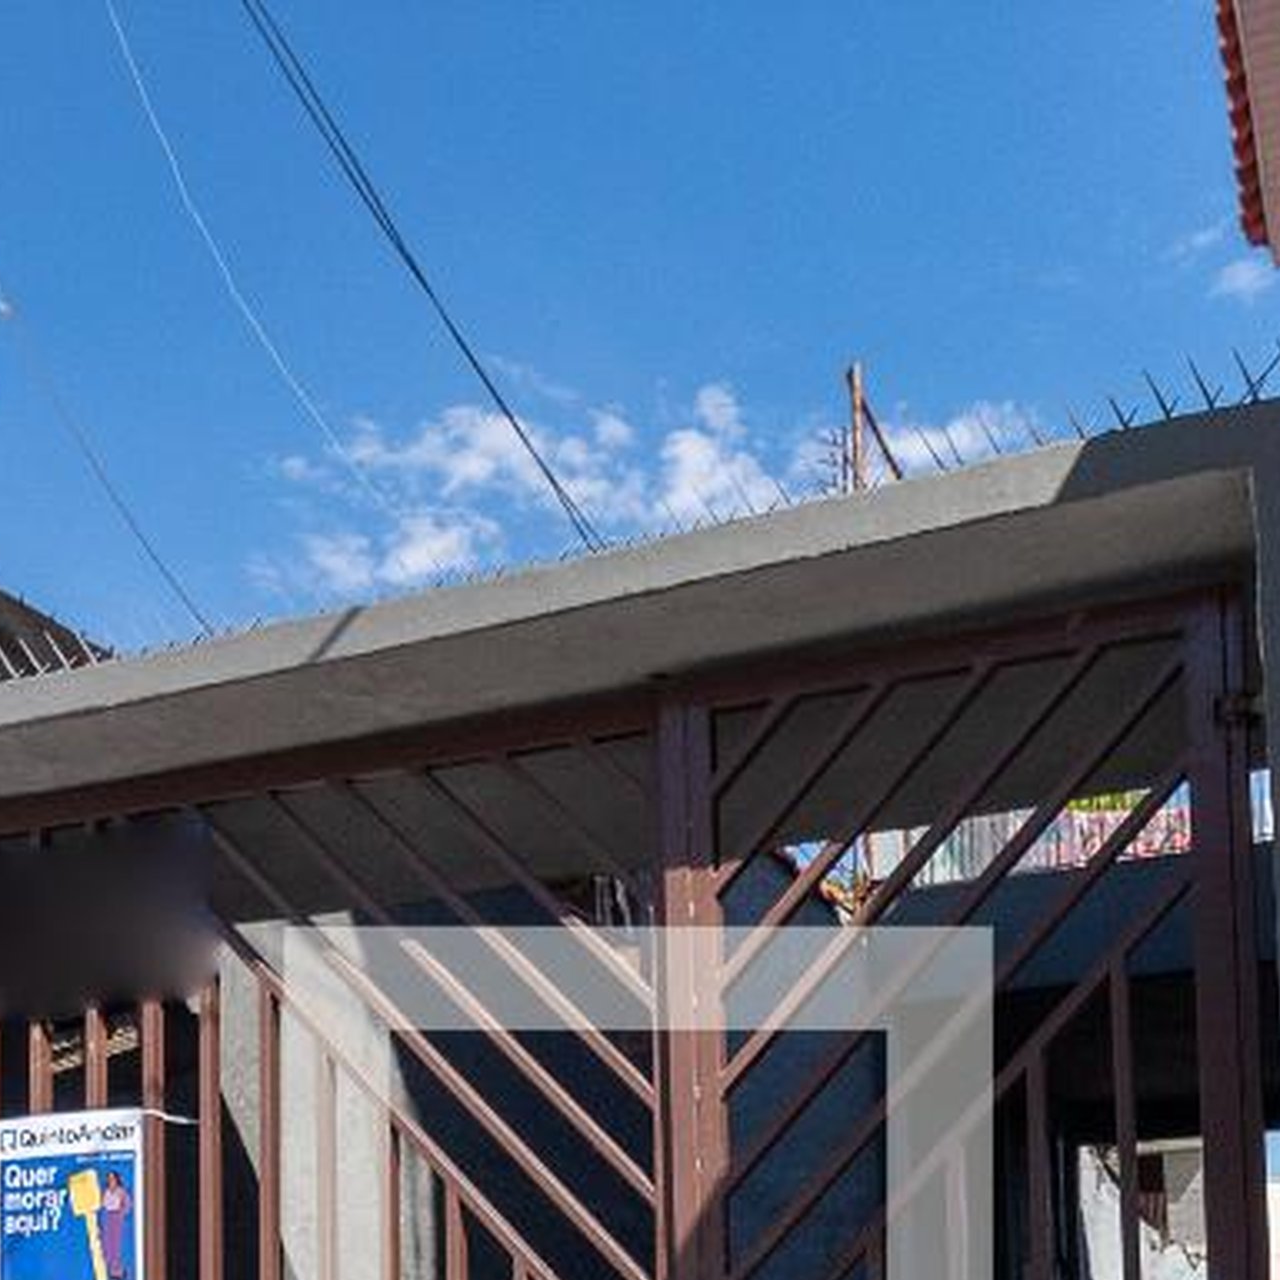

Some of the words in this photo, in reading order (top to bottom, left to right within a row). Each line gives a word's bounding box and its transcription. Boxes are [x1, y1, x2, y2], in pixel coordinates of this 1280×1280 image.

[4, 1165, 58, 1188] Quer
[4, 1189, 67, 1211] morar
[4, 1207, 61, 1237] aqui?
